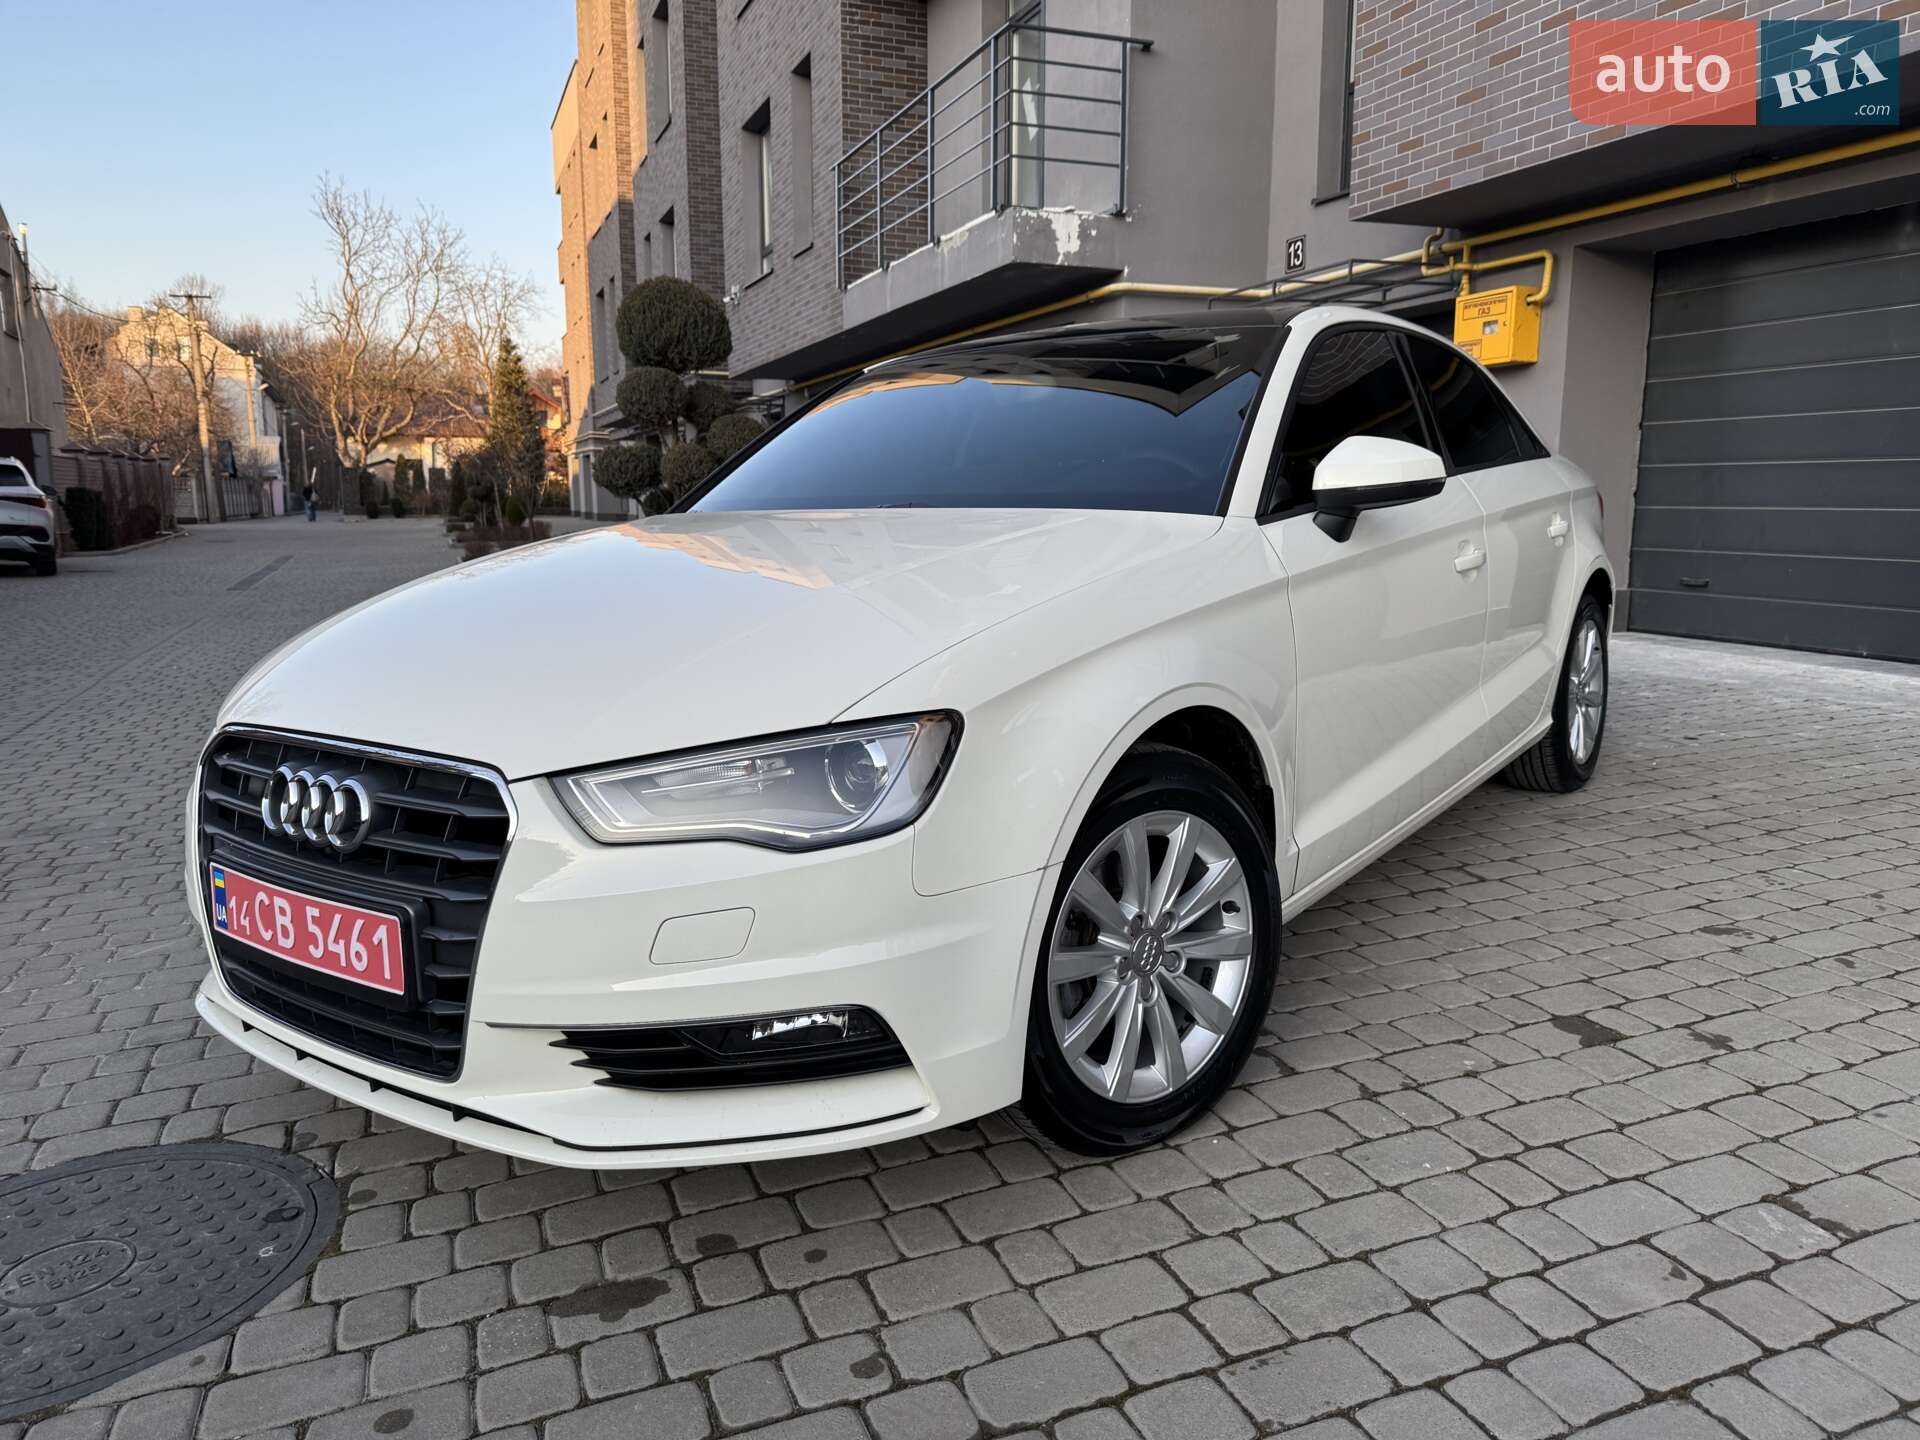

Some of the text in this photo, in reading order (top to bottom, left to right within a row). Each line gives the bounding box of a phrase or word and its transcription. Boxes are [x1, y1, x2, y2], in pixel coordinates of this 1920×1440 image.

[1288, 240, 1303, 267] 13
[216, 902, 228, 923] UA
[305, 905, 392, 980] 5461
